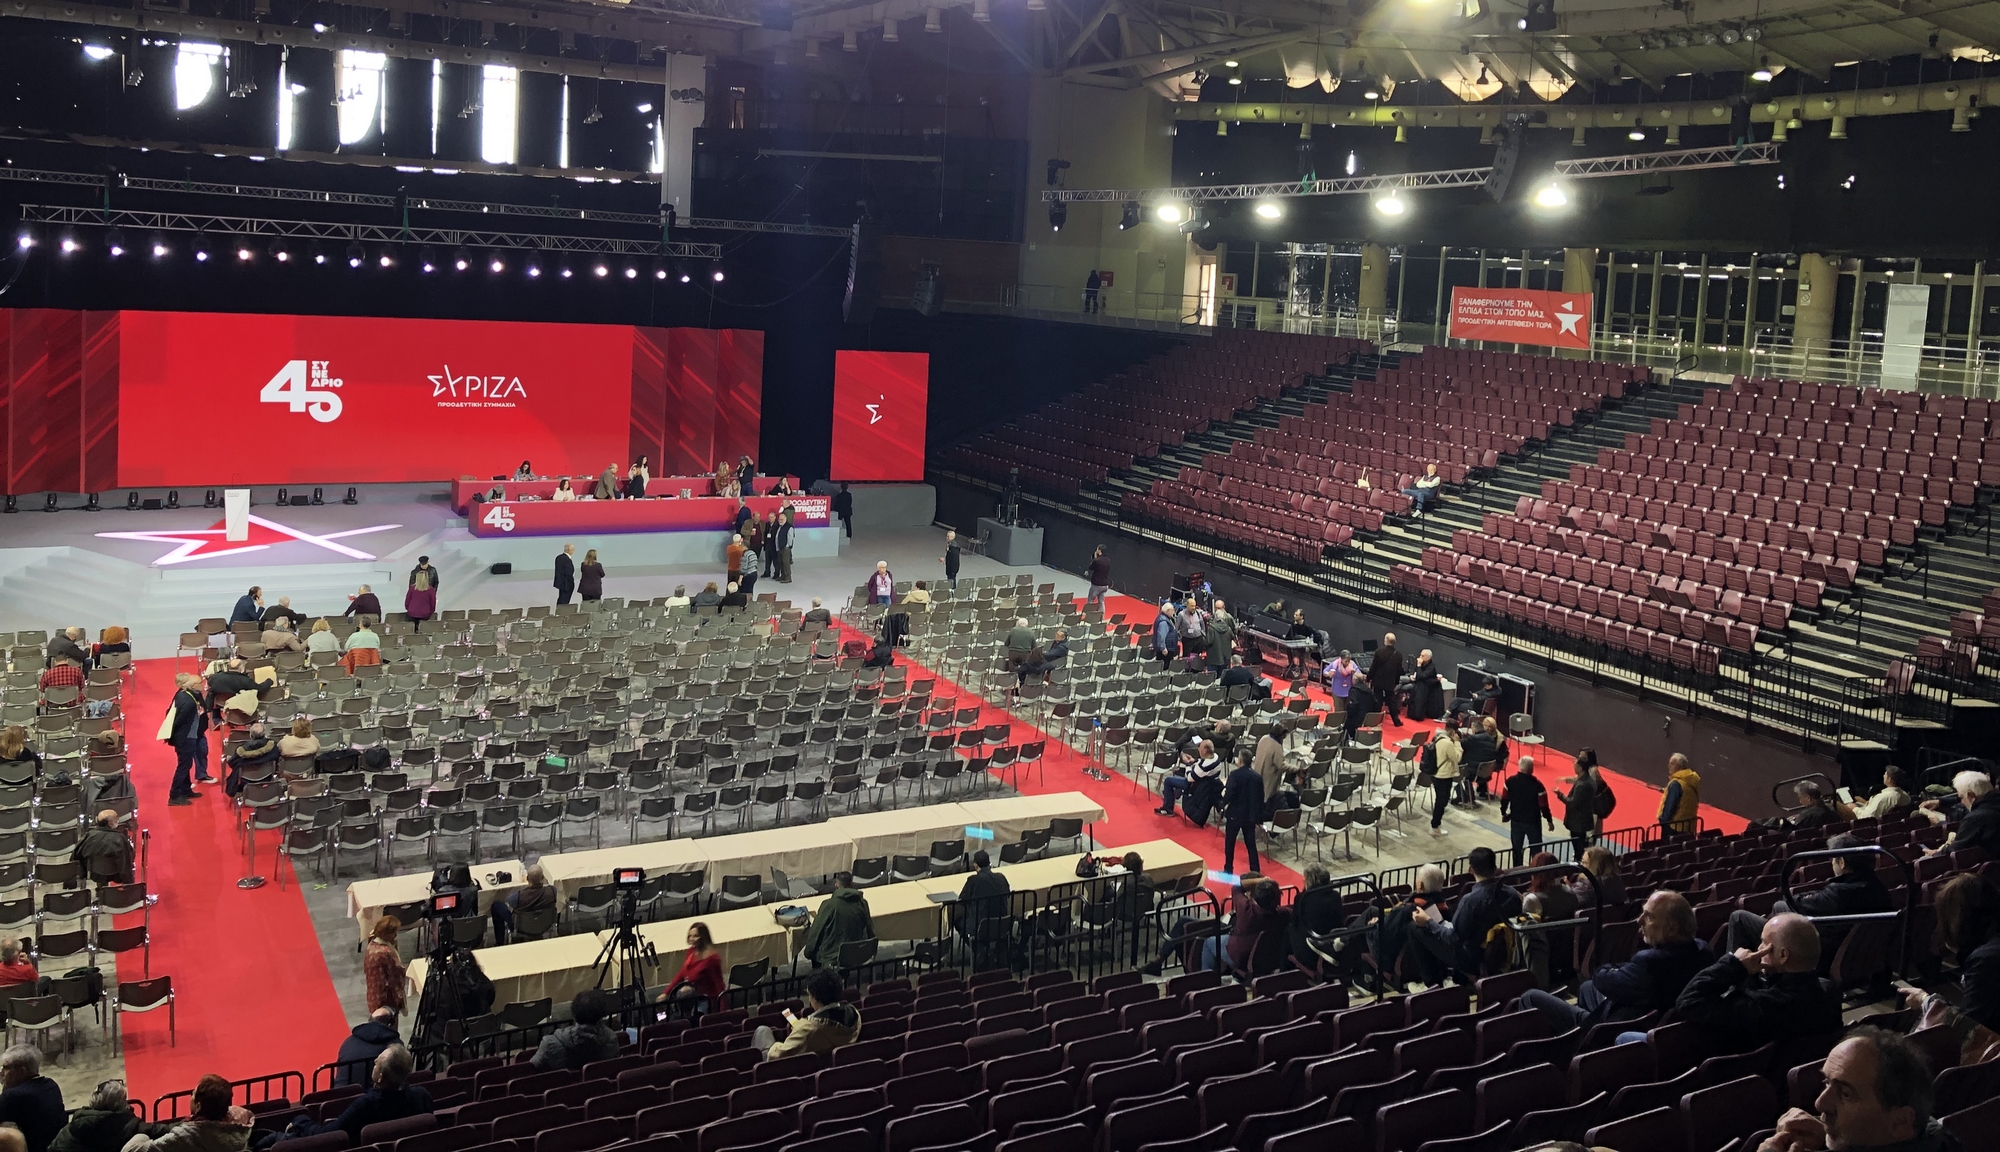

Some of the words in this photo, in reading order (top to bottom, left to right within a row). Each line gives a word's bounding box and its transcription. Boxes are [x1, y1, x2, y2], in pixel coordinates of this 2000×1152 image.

[1458, 298, 1515, 307] ΞΑΝΑΦΕΡΝΟΥΜΕ
[1517, 300, 1533, 308] ΤΗΝ
[1458, 306, 1483, 315] ΕΛΠΙΔΑ
[1484, 308, 1503, 316] ΣΤΟΝ
[1505, 309, 1526, 317] ΤΟΠΟ
[1527, 310, 1545, 319] ΜΑΣ
[1457, 317, 1496, 325] ΠΡΟΟΔΕΥΤΙΚΗ
[311, 360, 330, 370] ΣΥ
[311, 369, 328, 379] ΝΕ
[310, 378, 344, 388] ΔΡΙΟ
